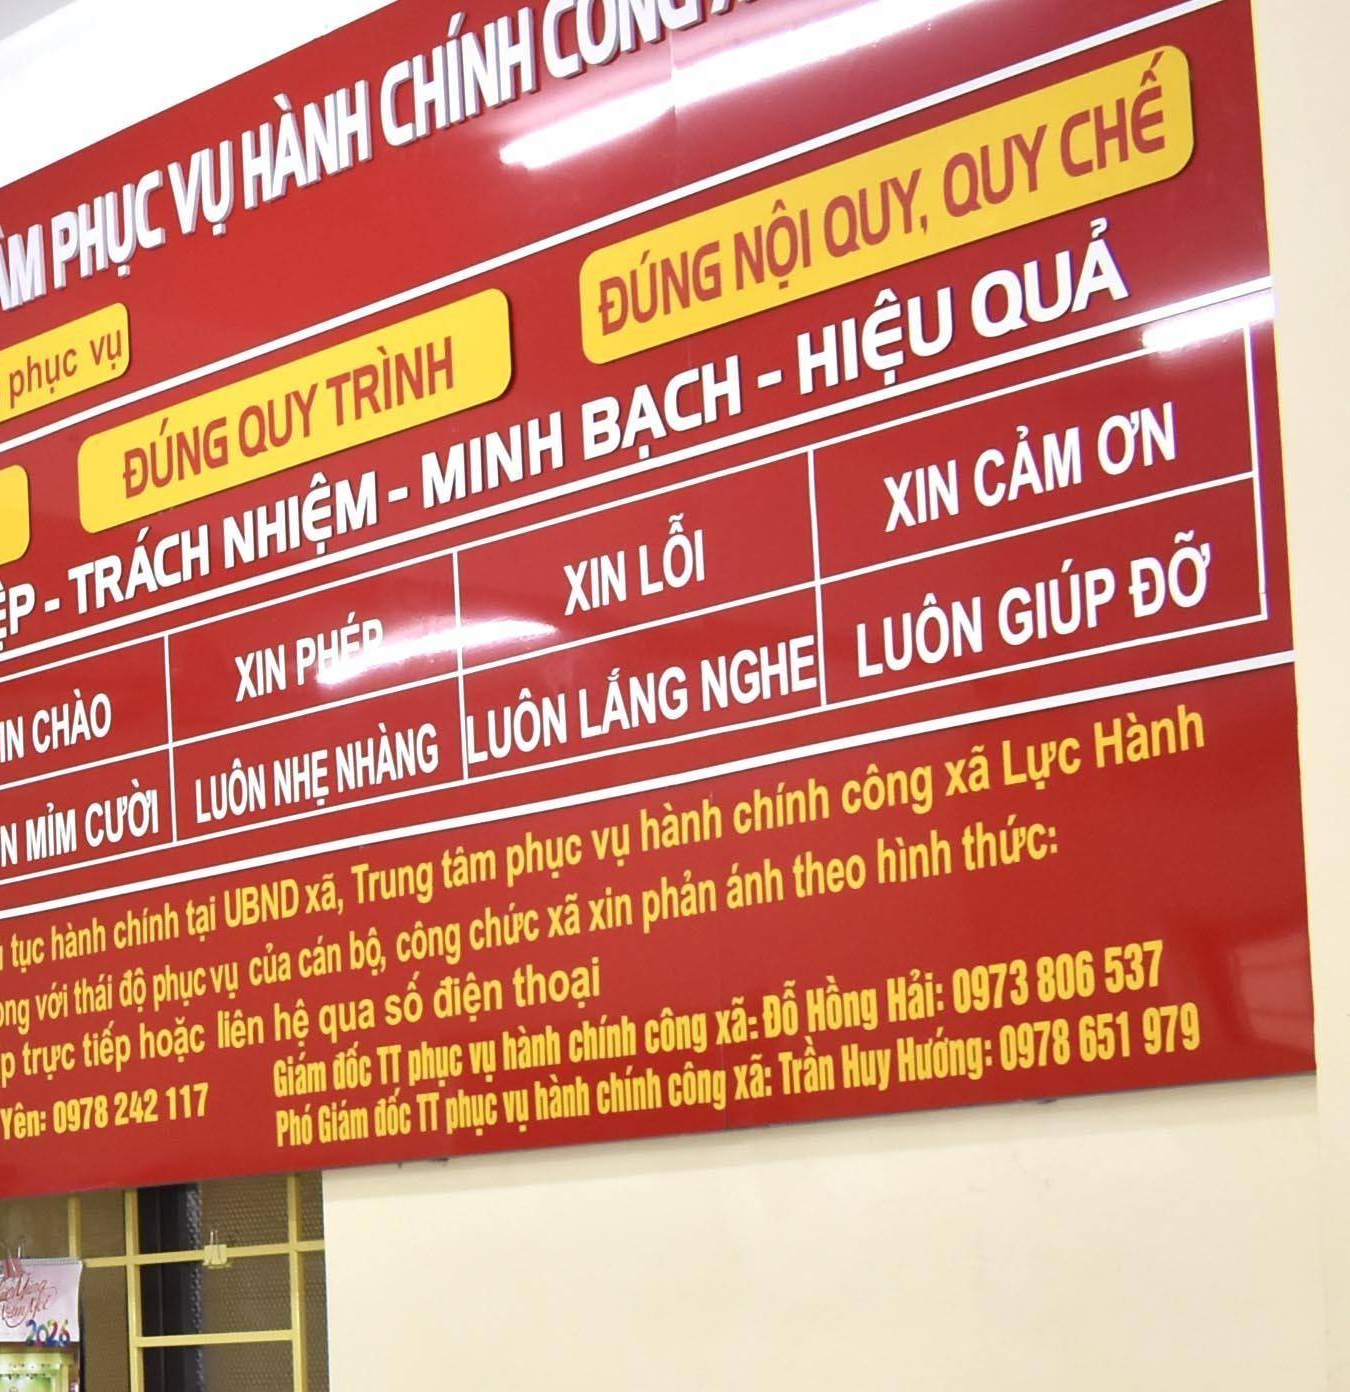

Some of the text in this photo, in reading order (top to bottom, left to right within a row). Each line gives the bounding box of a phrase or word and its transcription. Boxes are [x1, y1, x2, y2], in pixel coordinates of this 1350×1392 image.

[51, 170, 165, 289] PHỤC
[167, 140, 234, 236] VỤ
[241, 80, 372, 209] HÀNH
[381, 6, 537, 147] CHÍNH
[598, 50, 1166, 336] ĐÚNG NỘI QUY, QUY CHẾ
[9, 348, 77, 409] phục
[89, 330, 122, 366] vụ
[44, 598, 60, 612] -
[68, 524, 210, 614] TRÁCH
[223, 471, 377, 569] NHIỆM
[388, 486, 408, 502] -
[421, 411, 563, 509] MINH
[582, 355, 741, 460] BẠCH
[757, 370, 781, 388] -
[797, 287, 953, 395] HIỆU
[971, 217, 1128, 338] QUẢ
[122, 336, 454, 499] ĐÚNG QUY TRÌNH
[884, 402, 1175, 532] XIN CẢM ƠN
[563, 513, 705, 615] XIN LỖI
[857, 530, 1211, 678] LUÔN GIÚP ĐỠ
[32, 688, 112, 753] CHÀO
[235, 612, 384, 702] XIN PHÉP
[467, 635, 818, 764] LUÔN LẮNG NGHE
[25, 802, 77, 862] MỈM
[85, 778, 159, 847] CƯỜI
[195, 722, 439, 823] LUÔN NHẸ NHÀNG
[11, 934, 44, 973] tục
[51, 917, 106, 960] hành
[114, 903, 179, 949] chính
[185, 896, 216, 942] tại
[224, 879, 299, 927] UBND
[305, 873, 344, 914] xã,
[351, 862, 433, 904] Trung
[441, 846, 496, 888] tâm
[506, 832, 582, 887] phục
[591, 824, 630, 867] vụ
[640, 799, 722, 852] hành
[733, 778, 829, 834] chính
[841, 763, 933, 814] công
[945, 745, 989, 796] xã
[1003, 738, 1081, 790] Lực
[1094, 704, 1204, 768] Hành
[273, 940, 1163, 1097] Giám đốc TT phục vụ hành chính công xã: Đỗ Hồng Hải: 0973 806 537
[0, 1102, 46, 1140] Yên:
[53, 1095, 108, 1133] 0978
[114, 1088, 158, 1126] 242
[165, 1082, 208, 1120] 117
